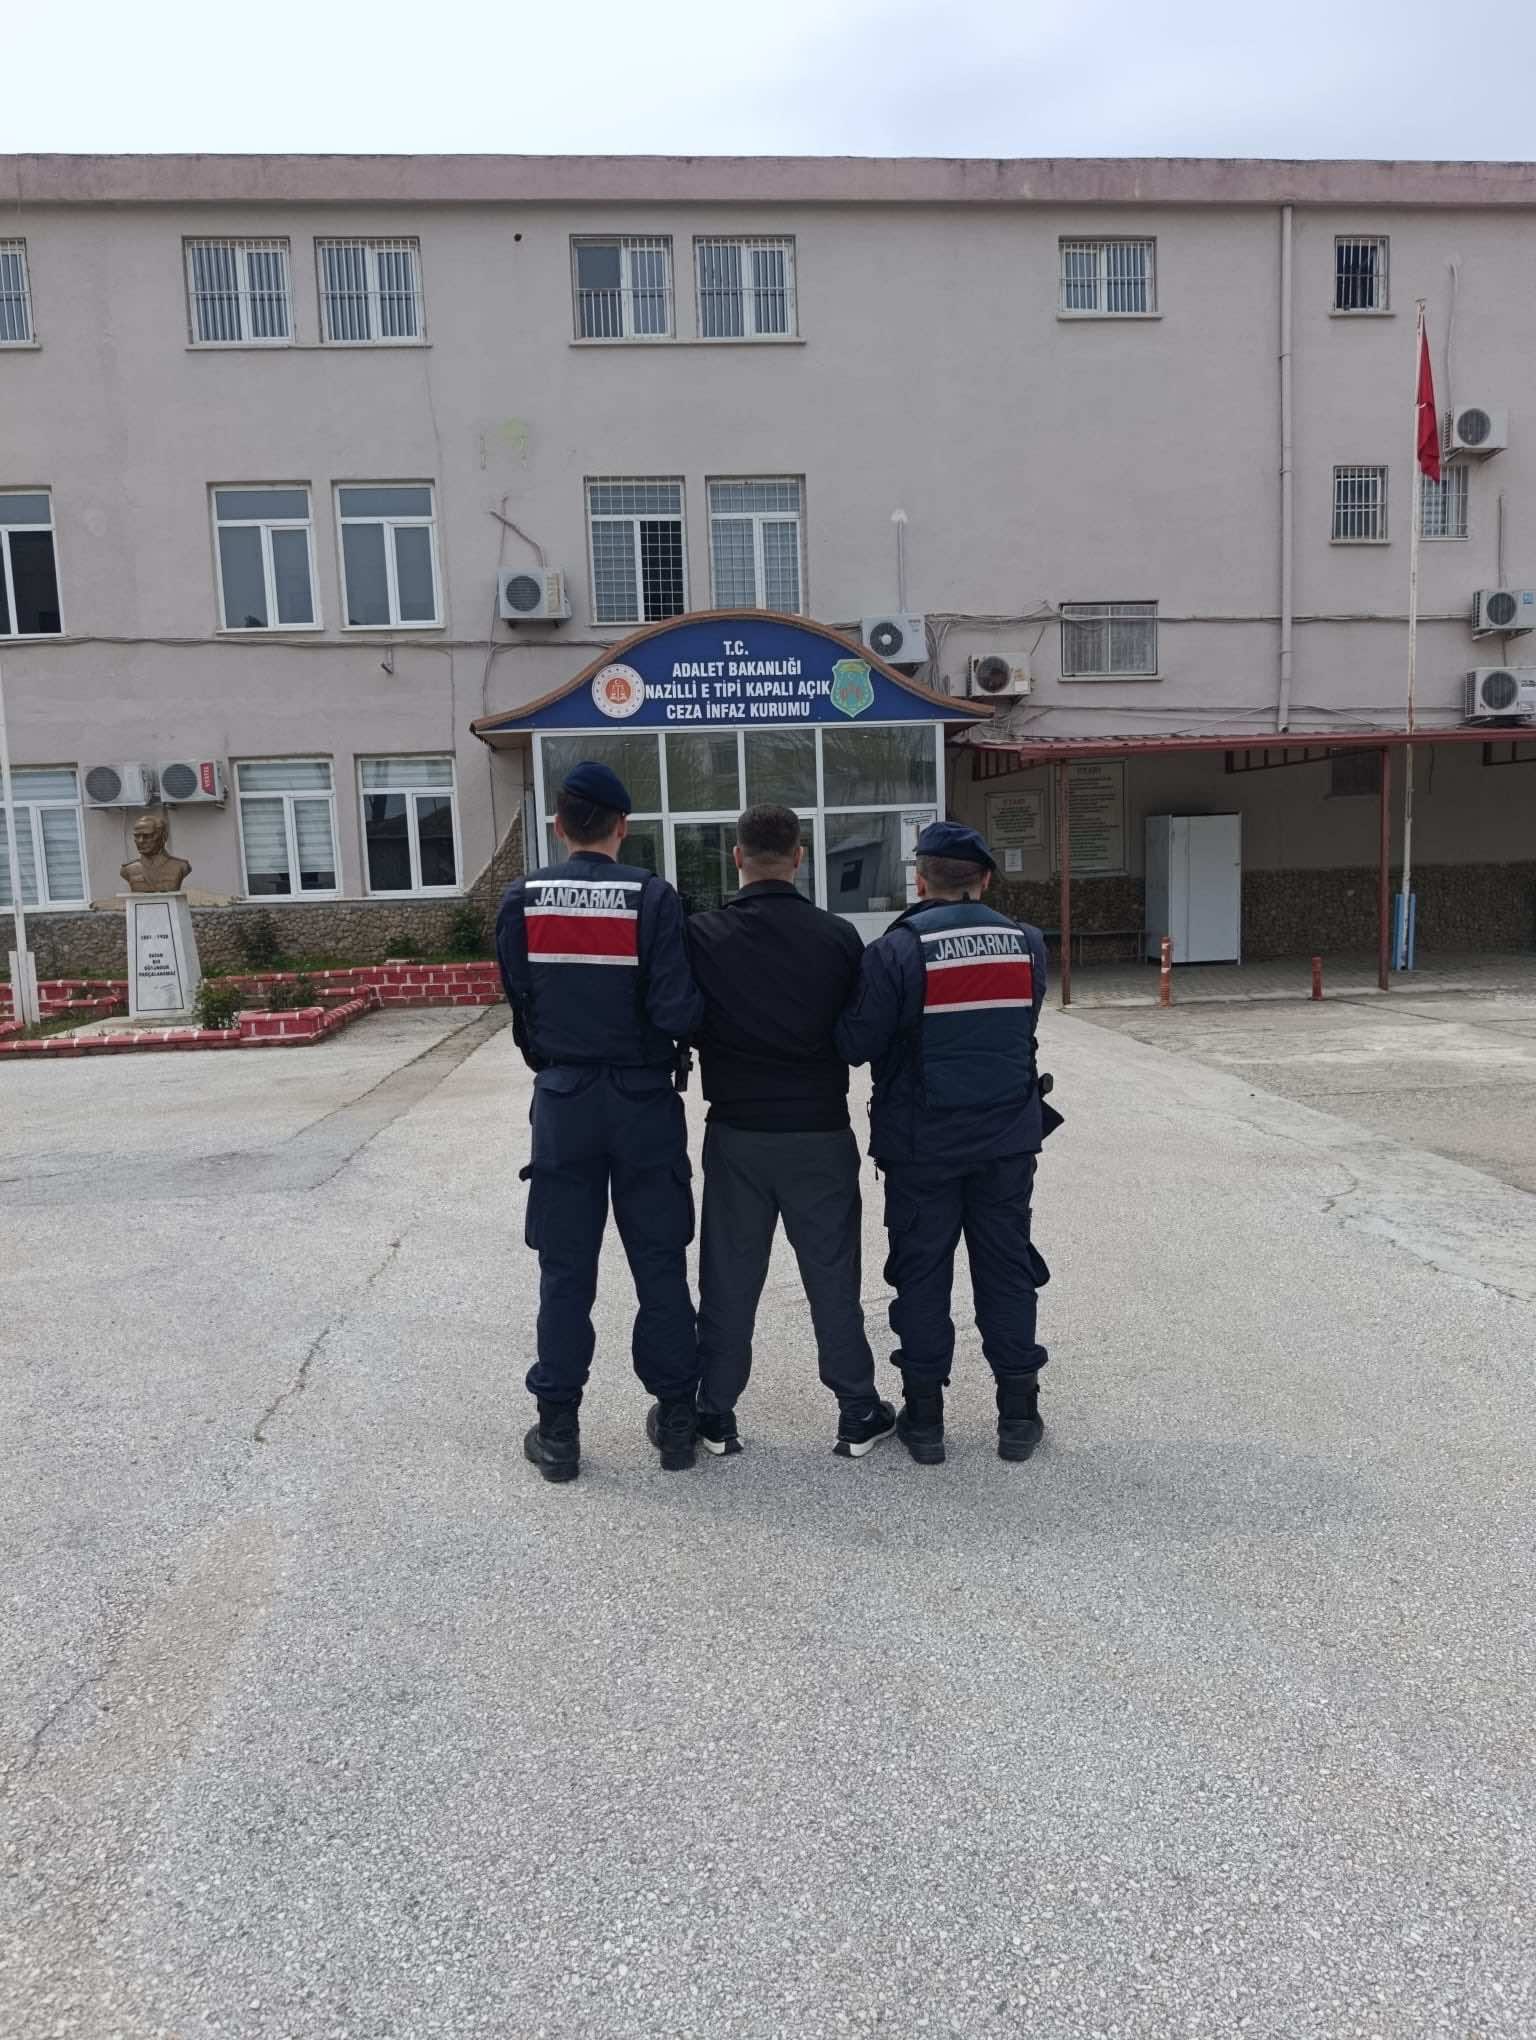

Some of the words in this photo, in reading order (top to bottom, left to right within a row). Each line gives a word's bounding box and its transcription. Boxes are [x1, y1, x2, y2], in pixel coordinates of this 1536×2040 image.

[723, 640, 749, 656] T.C.
[672, 662, 725, 677] ADALET
[728, 657, 801, 677] BAKANLIĞI
[645, 681, 696, 699] NAZİLLİ
[701, 683, 710, 698] E
[713, 680, 741, 698] TİPİ
[745, 681, 793, 697] KAPALI
[797, 680, 831, 699] AÇIK
[666, 704, 703, 719] CEZA
[706, 701, 746, 719] İNFAZ
[750, 701, 810, 717] KURUMU
[535, 887, 627, 909] JANDARMA
[935, 934, 1022, 960] JANDARMA
